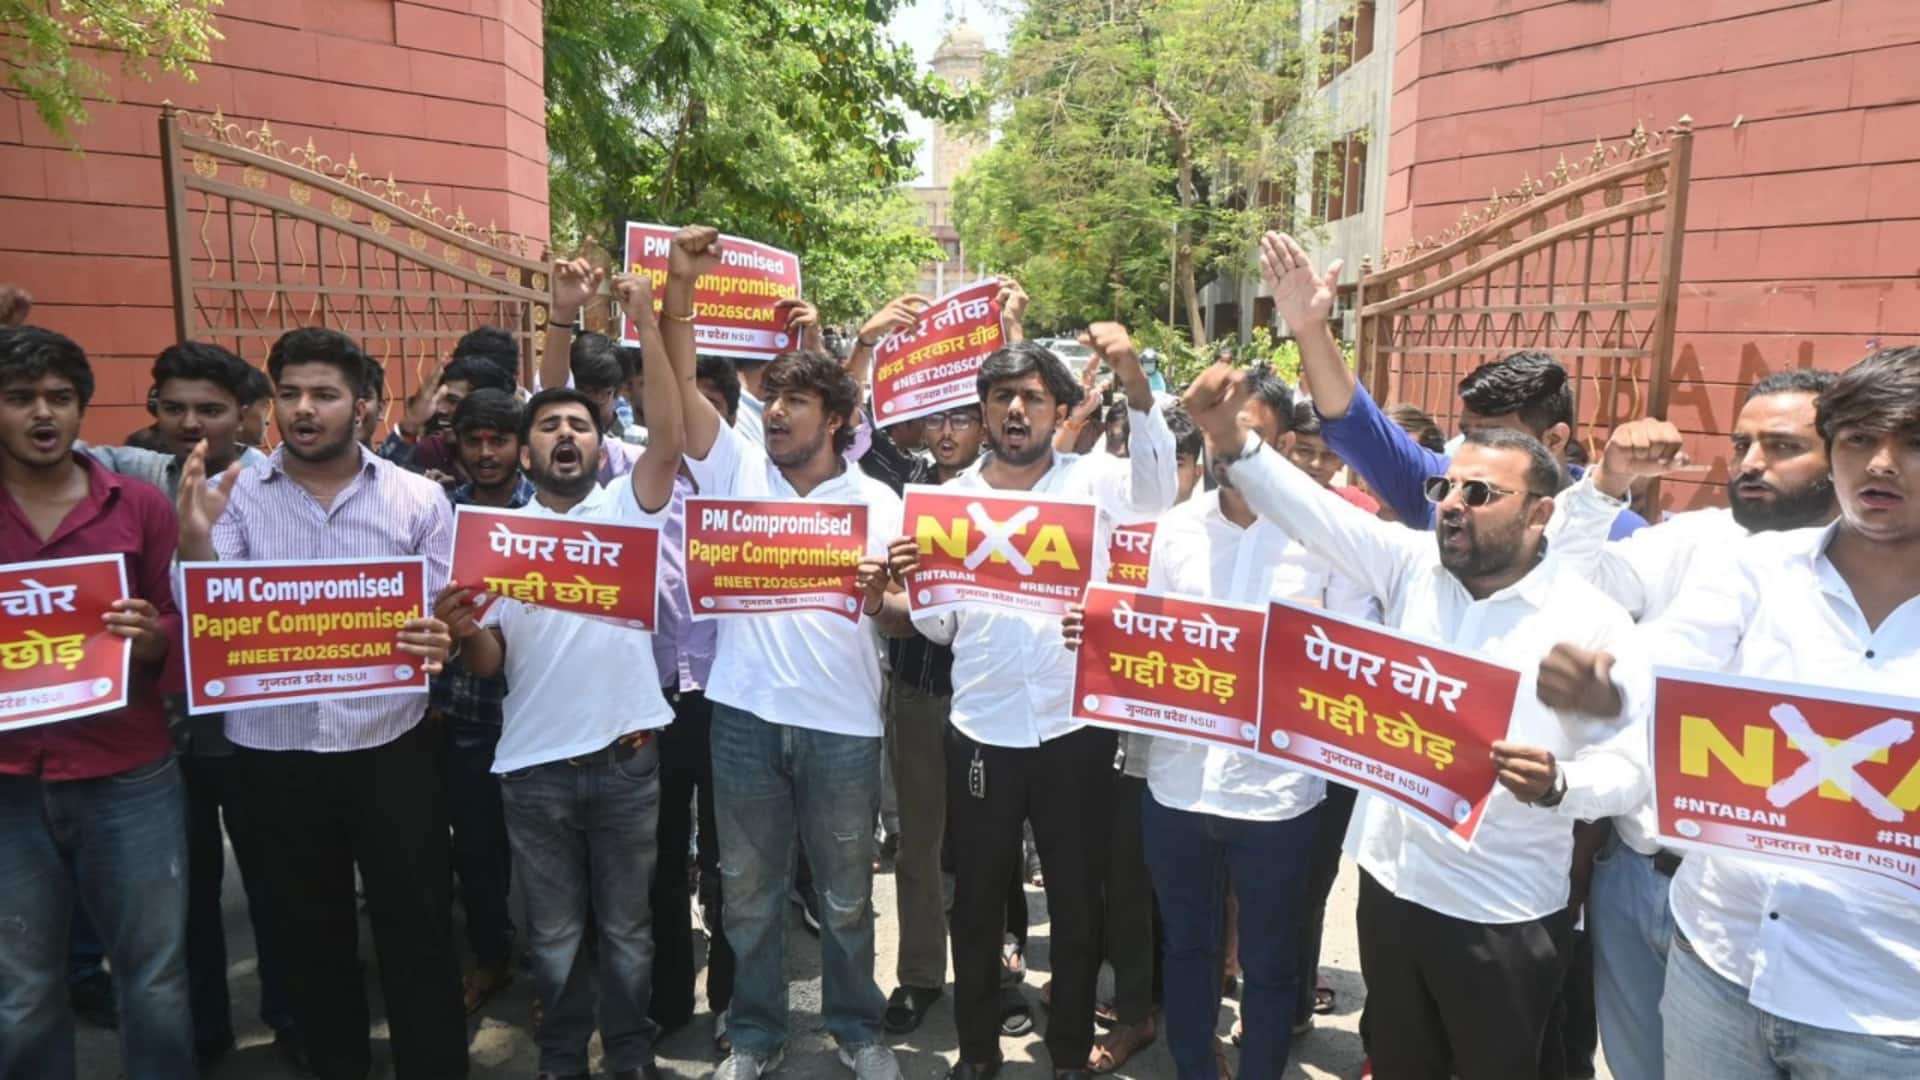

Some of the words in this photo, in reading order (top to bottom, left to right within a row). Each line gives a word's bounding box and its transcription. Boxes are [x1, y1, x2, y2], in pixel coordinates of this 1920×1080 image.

[643, 236, 671, 259] PM
[721, 251, 784, 275] romised
[694, 274, 796, 297] ompromised
[653, 299, 775, 322] #T2026SCAM
[932, 295, 990, 331] लीक
[907, 336, 966, 366] सरकार
[701, 508, 728, 532] PM
[732, 509, 852, 539] Compromised
[489, 522, 559, 563] पेपर
[562, 530, 623, 567] चोर
[689, 538, 739, 567] Paper
[742, 541, 863, 570] Compromised
[0, 579, 78, 616] चोर
[206, 577, 244, 604] PM
[249, 571, 405, 605] Compromised
[552, 574, 621, 611] छोड़
[713, 575, 843, 590] #NEET2026SCAM
[192, 612, 263, 642] Paper
[266, 604, 420, 637] Compromised
[1112, 599, 1178, 642] पेपर
[1180, 612, 1240, 652] चोर
[0, 629, 86, 671] छोड़
[226, 641, 392, 667] #NEET2026SCAM
[1304, 624, 1386, 687] पेपर
[1389, 655, 1468, 713] चोर
[1109, 651, 1167, 689] गद्दी
[1171, 658, 1237, 705] छोड़
[1298, 687, 1369, 737] गद्दी
[1374, 711, 1456, 771] छोड़
[1320, 746, 1363, 771] गुजरात
[1397, 776, 1430, 798] NSUI
[1673, 795, 1787, 828] #NTABAN
[1745, 832, 1811, 853] गुजरात
[1866, 854, 1916, 876] NSUI
